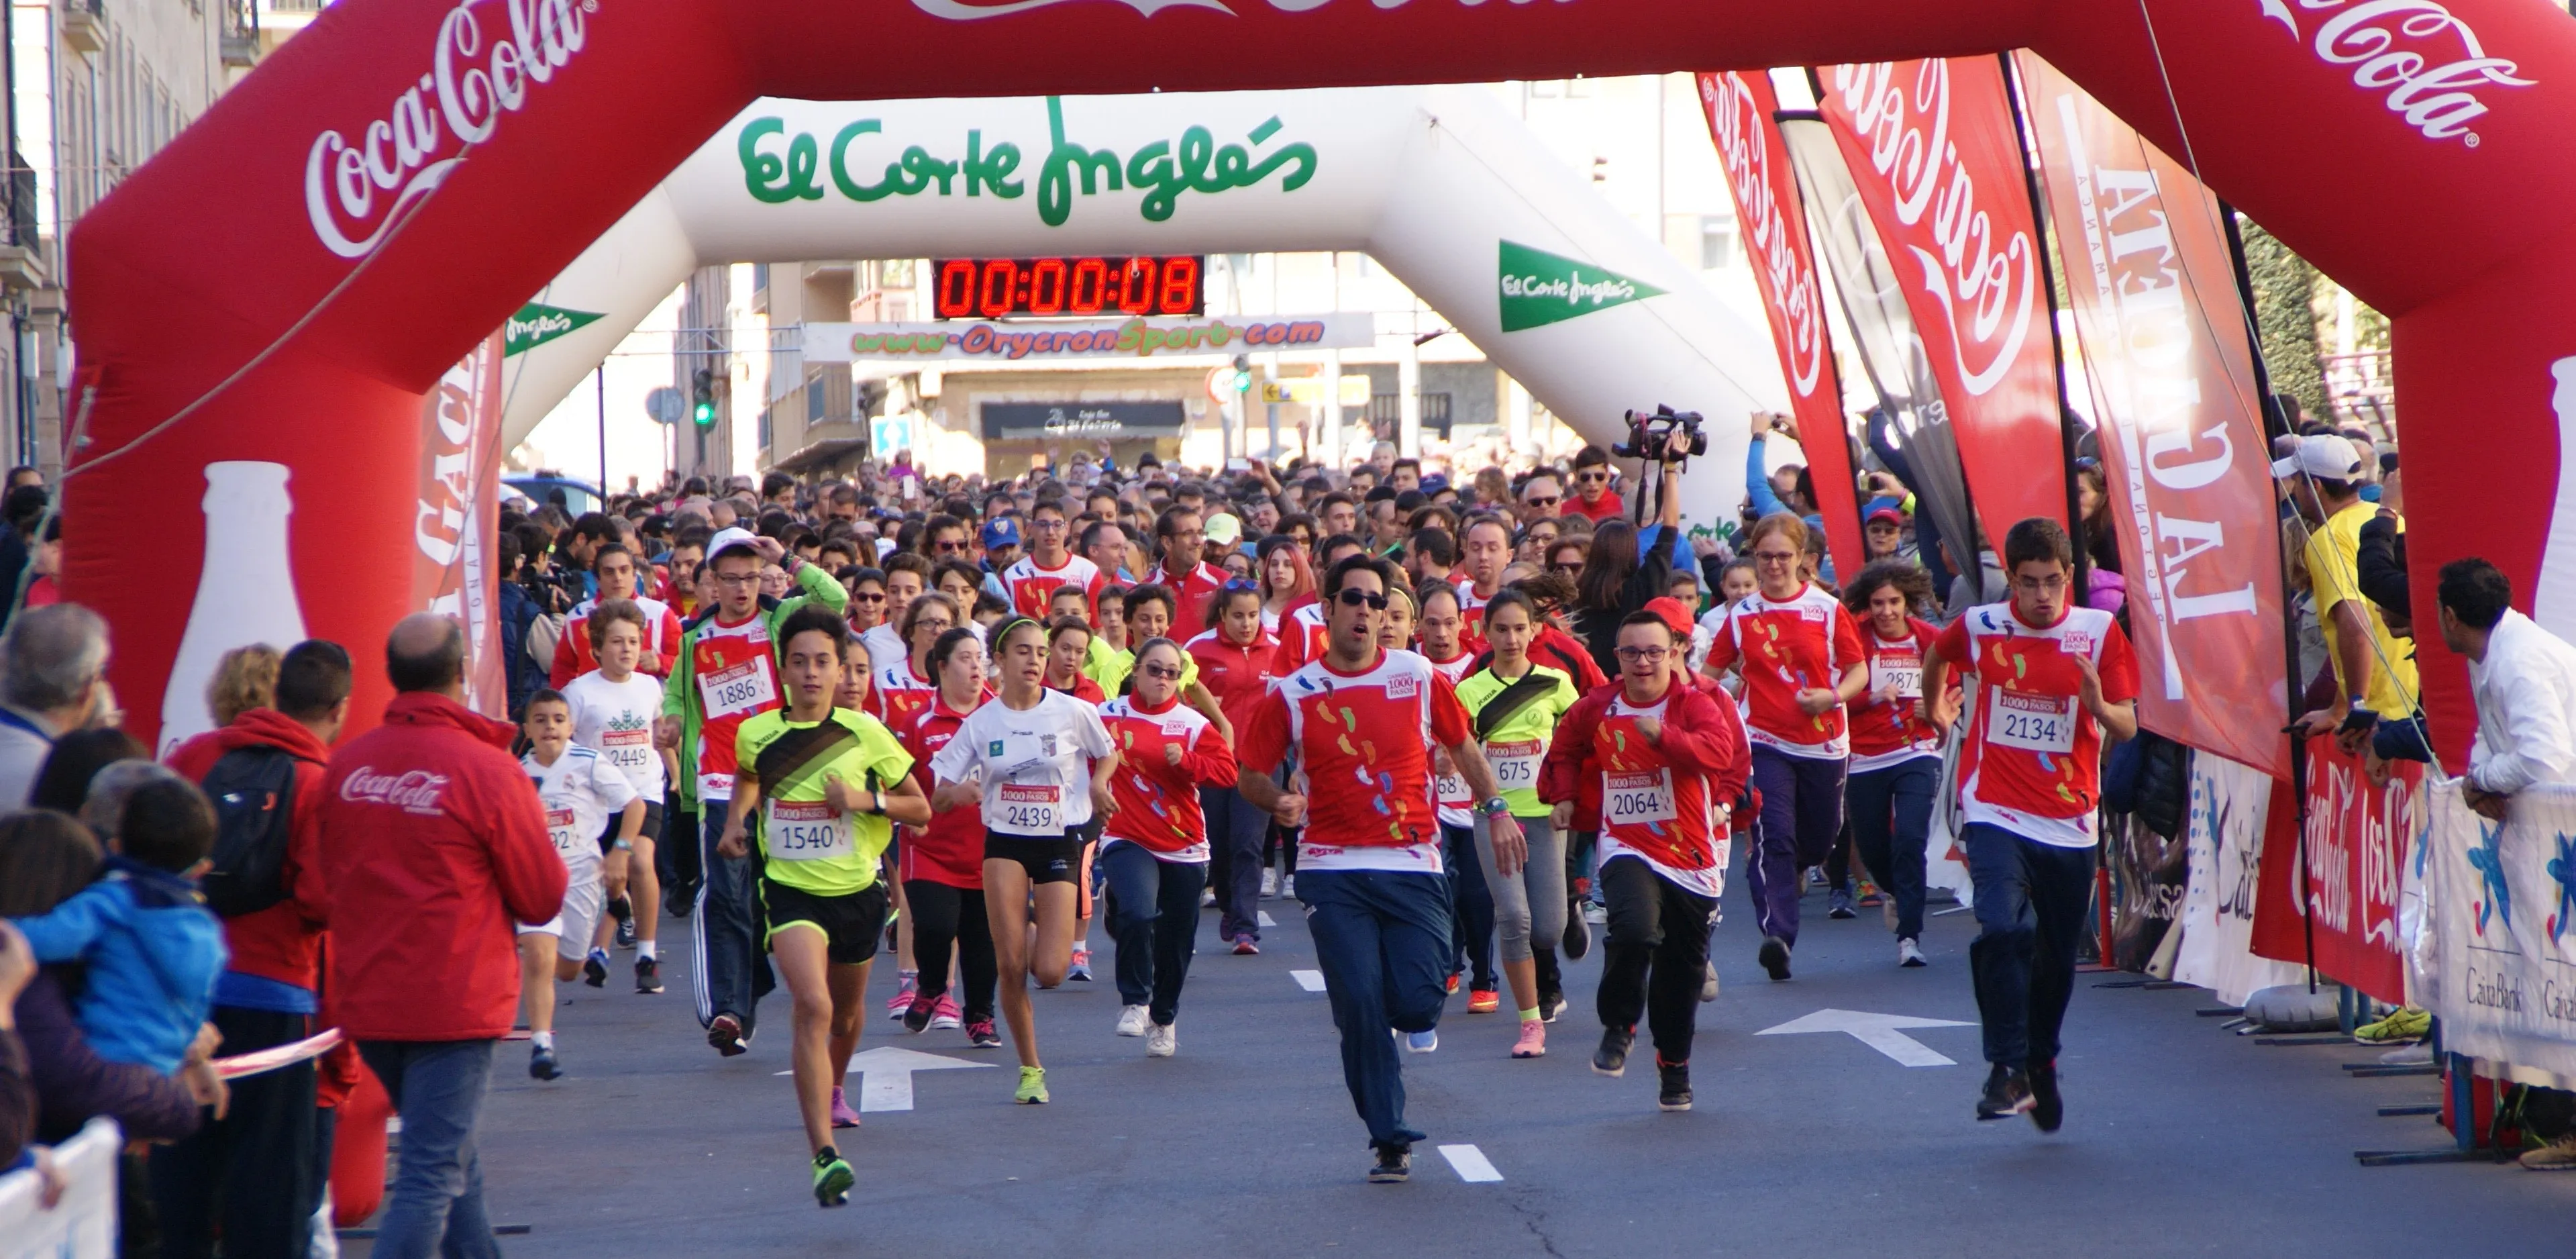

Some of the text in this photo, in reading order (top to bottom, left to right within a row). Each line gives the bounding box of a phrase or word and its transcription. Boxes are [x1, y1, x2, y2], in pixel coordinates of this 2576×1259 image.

[738, 95, 1318, 228] El Corte Inglés
[939, 256, 1198, 317] 00:00:08
[1501, 270, 1635, 305] El Corte Inglés
[1388, 676, 1414, 689] 1000
[1886, 672, 1922, 689] 2871
[717, 678, 756, 707] 1886
[2002, 695, 2056, 712] 1000 PASOS
[2005, 713, 2057, 742] 2134
[611, 748, 646, 766] 2449
[1488, 747, 1510, 758] 1000
[1499, 761, 1531, 780] 675
[1608, 778, 1652, 789] 1000 PASOS
[1002, 790, 1026, 801] 1000
[1614, 793, 1659, 815] 2064
[775, 807, 801, 819] 1000
[1008, 806, 1051, 827] 2439
[781, 824, 833, 850] 1540
